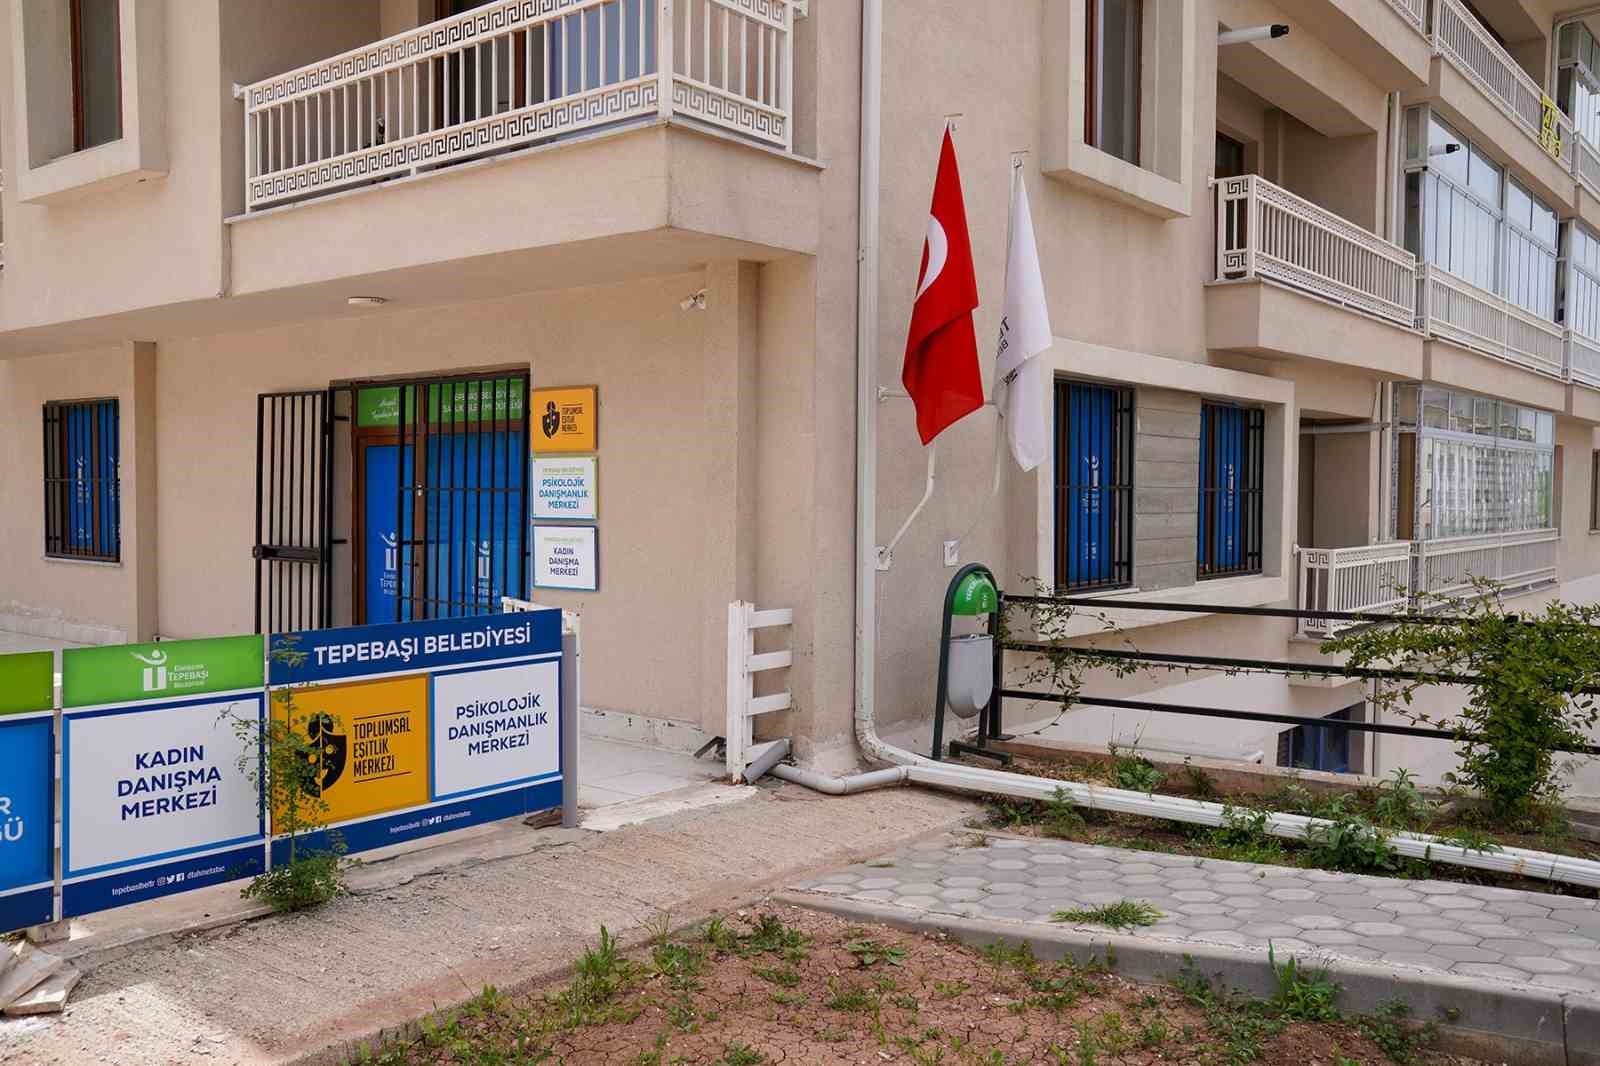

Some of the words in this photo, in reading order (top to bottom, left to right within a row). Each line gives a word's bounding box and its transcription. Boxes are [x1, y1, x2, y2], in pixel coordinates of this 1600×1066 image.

[542, 476, 585, 487] PSİKOLOJİK
[539, 489, 588, 499] DANIŞMANLIK
[548, 556, 580, 567] DANIŞMA
[553, 547, 574, 555] KADIN
[550, 566, 579, 576] MERKEZİ
[314, 637, 419, 665] TEPEBAŞI
[424, 622, 531, 654] BELEDİYESİ
[456, 692, 541, 720] PSİKOLOJİK
[353, 717, 411, 740] TOPLUMSAL
[448, 711, 548, 741] DANIŞMANLIK
[468, 729, 530, 756] MERKEZİ
[135, 745, 204, 770] KADIN
[353, 755, 395, 777] MERKEZİ
[117, 766, 222, 797] DANIŞMA
[121, 785, 217, 821] MERKEZİ
